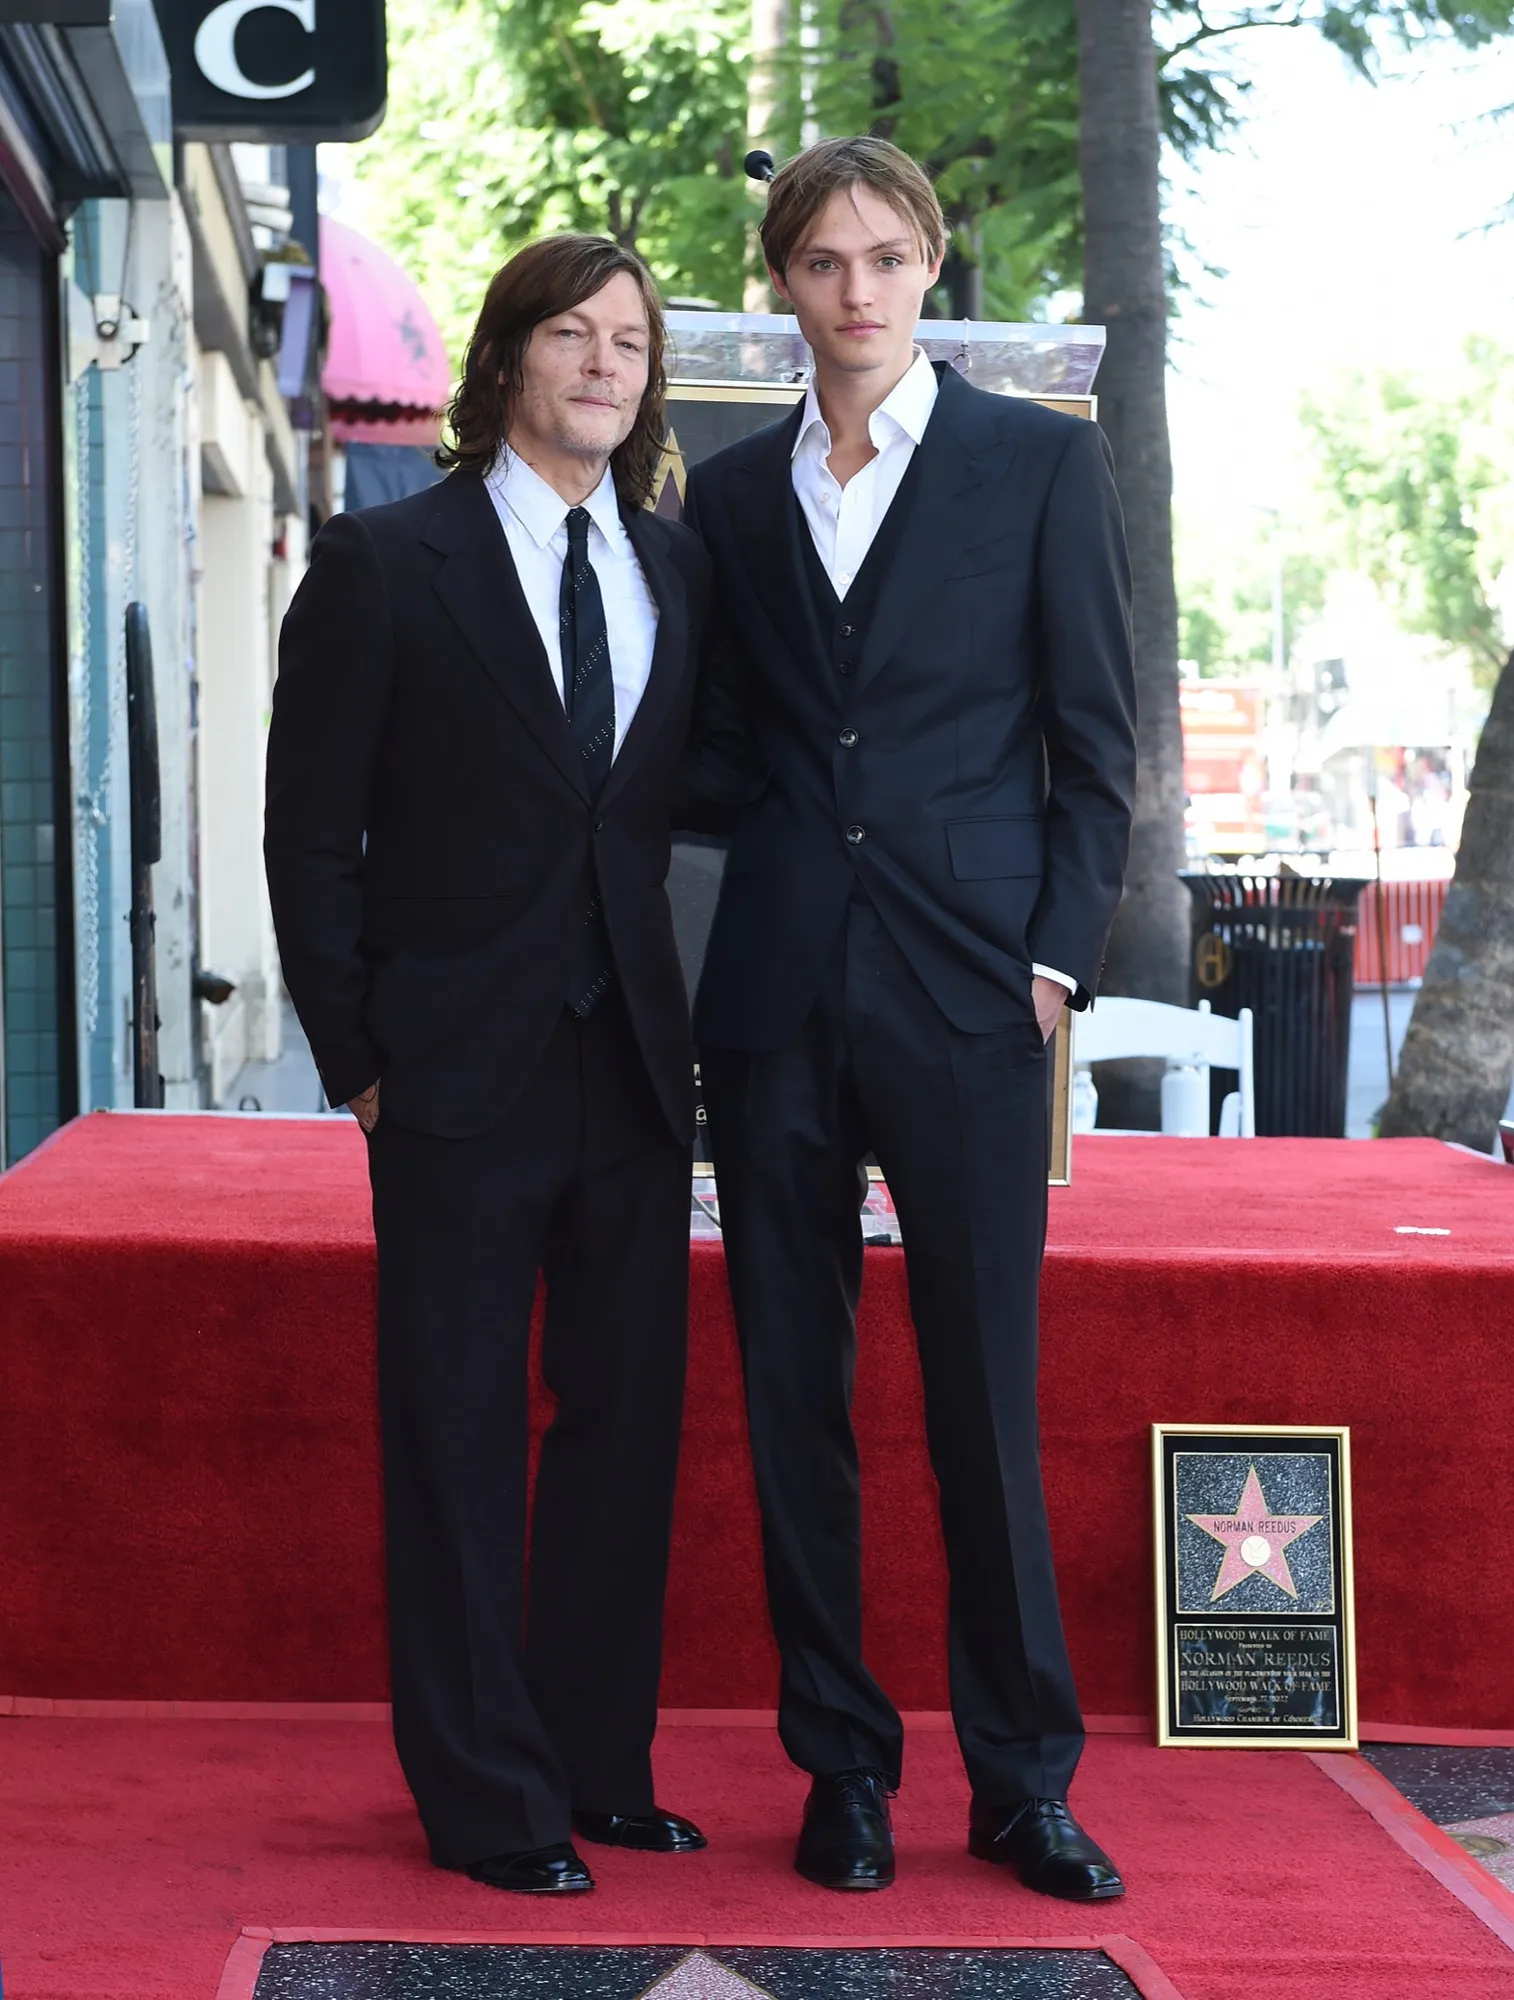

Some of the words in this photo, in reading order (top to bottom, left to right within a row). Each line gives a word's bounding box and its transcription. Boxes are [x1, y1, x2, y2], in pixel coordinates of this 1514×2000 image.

[194, 0, 316, 100] C
[1213, 1521, 1254, 1533] NORMAN
[1258, 1521, 1297, 1533] REEDUS
[1180, 1629, 1246, 1640] HOLLYWOOD
[1248, 1630, 1280, 1641] WALK
[1283, 1630, 1297, 1641] OF
[1300, 1630, 1331, 1641] FAME
[1181, 1652, 1256, 1666] NORMAN
[1264, 1652, 1331, 1667] REEDUS
[1180, 1680, 1247, 1691] HOLLYWOOD
[1249, 1681, 1282, 1691] WALK
[1284, 1681, 1298, 1692] OF
[1301, 1681, 1332, 1692] FAME
